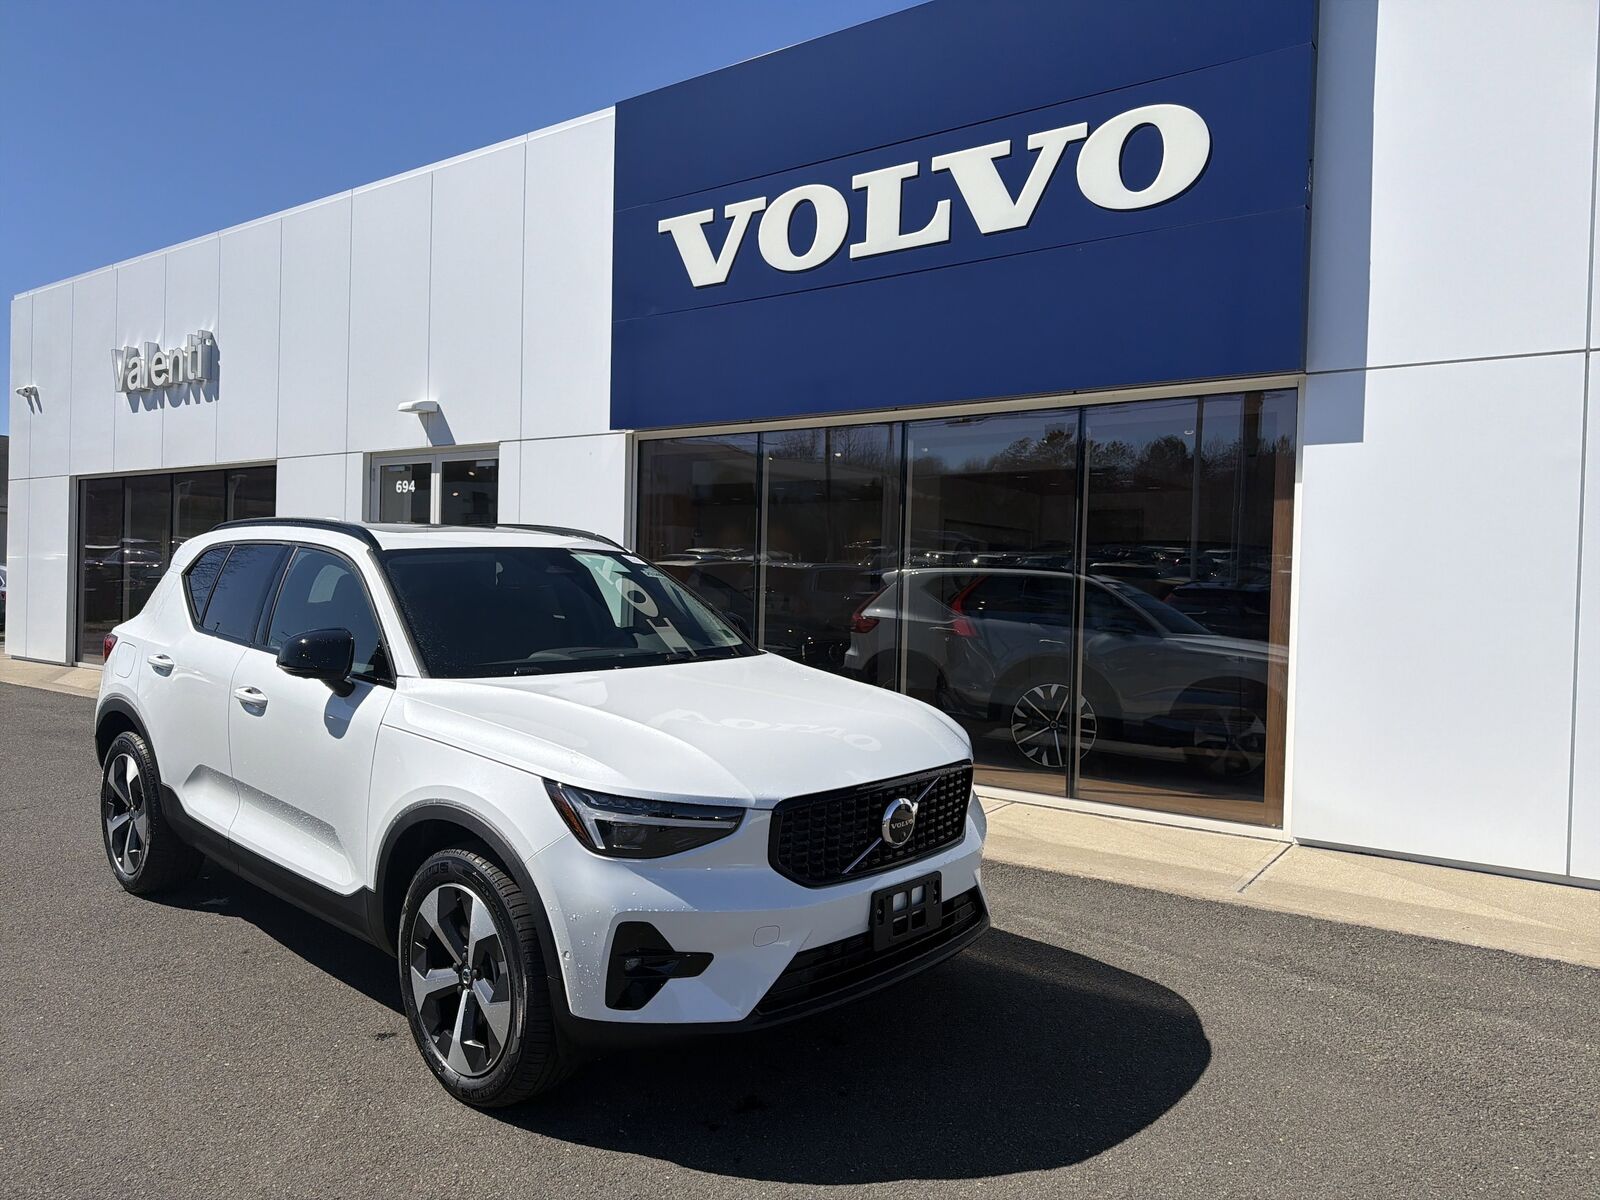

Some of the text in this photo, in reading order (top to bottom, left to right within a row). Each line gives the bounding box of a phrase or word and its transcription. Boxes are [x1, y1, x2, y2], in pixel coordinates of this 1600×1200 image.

[657, 103, 1211, 287] VOLVO
[111, 330, 212, 392] Valenti
[395, 480, 416, 493] 694
[890, 818, 914, 830] VOLVO
